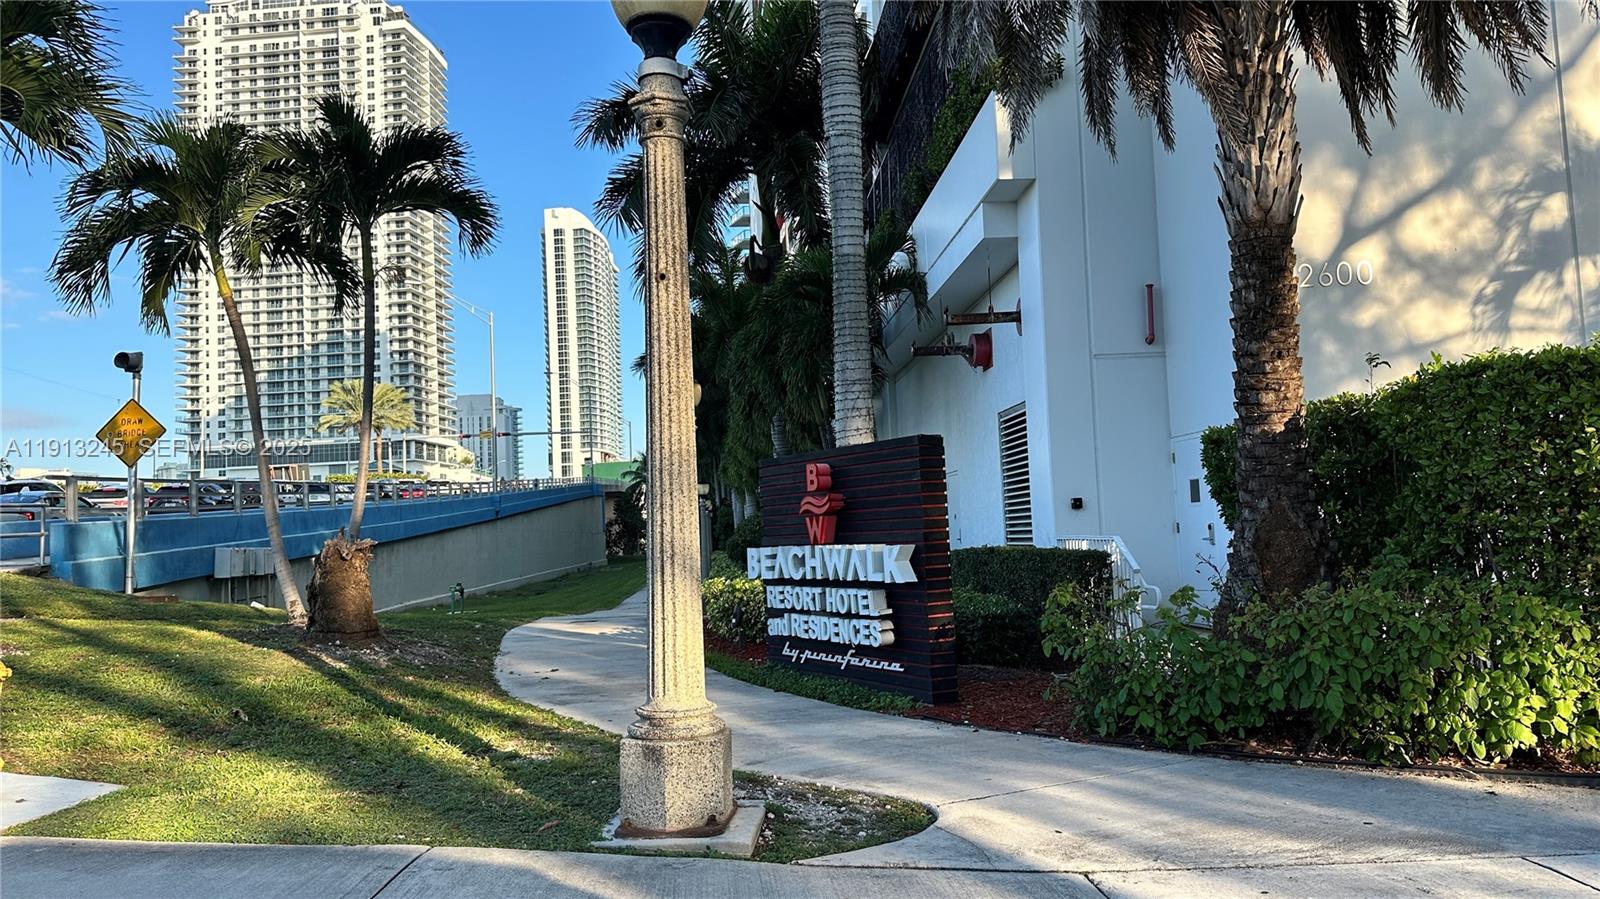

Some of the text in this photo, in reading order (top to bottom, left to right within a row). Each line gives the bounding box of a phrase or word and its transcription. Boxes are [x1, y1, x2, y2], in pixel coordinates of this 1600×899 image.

[1297, 260, 1374, 288] 2600
[117, 428, 146, 437] BRIDGE
[121, 417, 144, 426] DRAW
[747, 544, 917, 583] BEACHWALK
[766, 586, 887, 617] RESORT HOTEL
[767, 613, 888, 648] and RESIDENCES
[782, 641, 905, 672] by pininfarina
